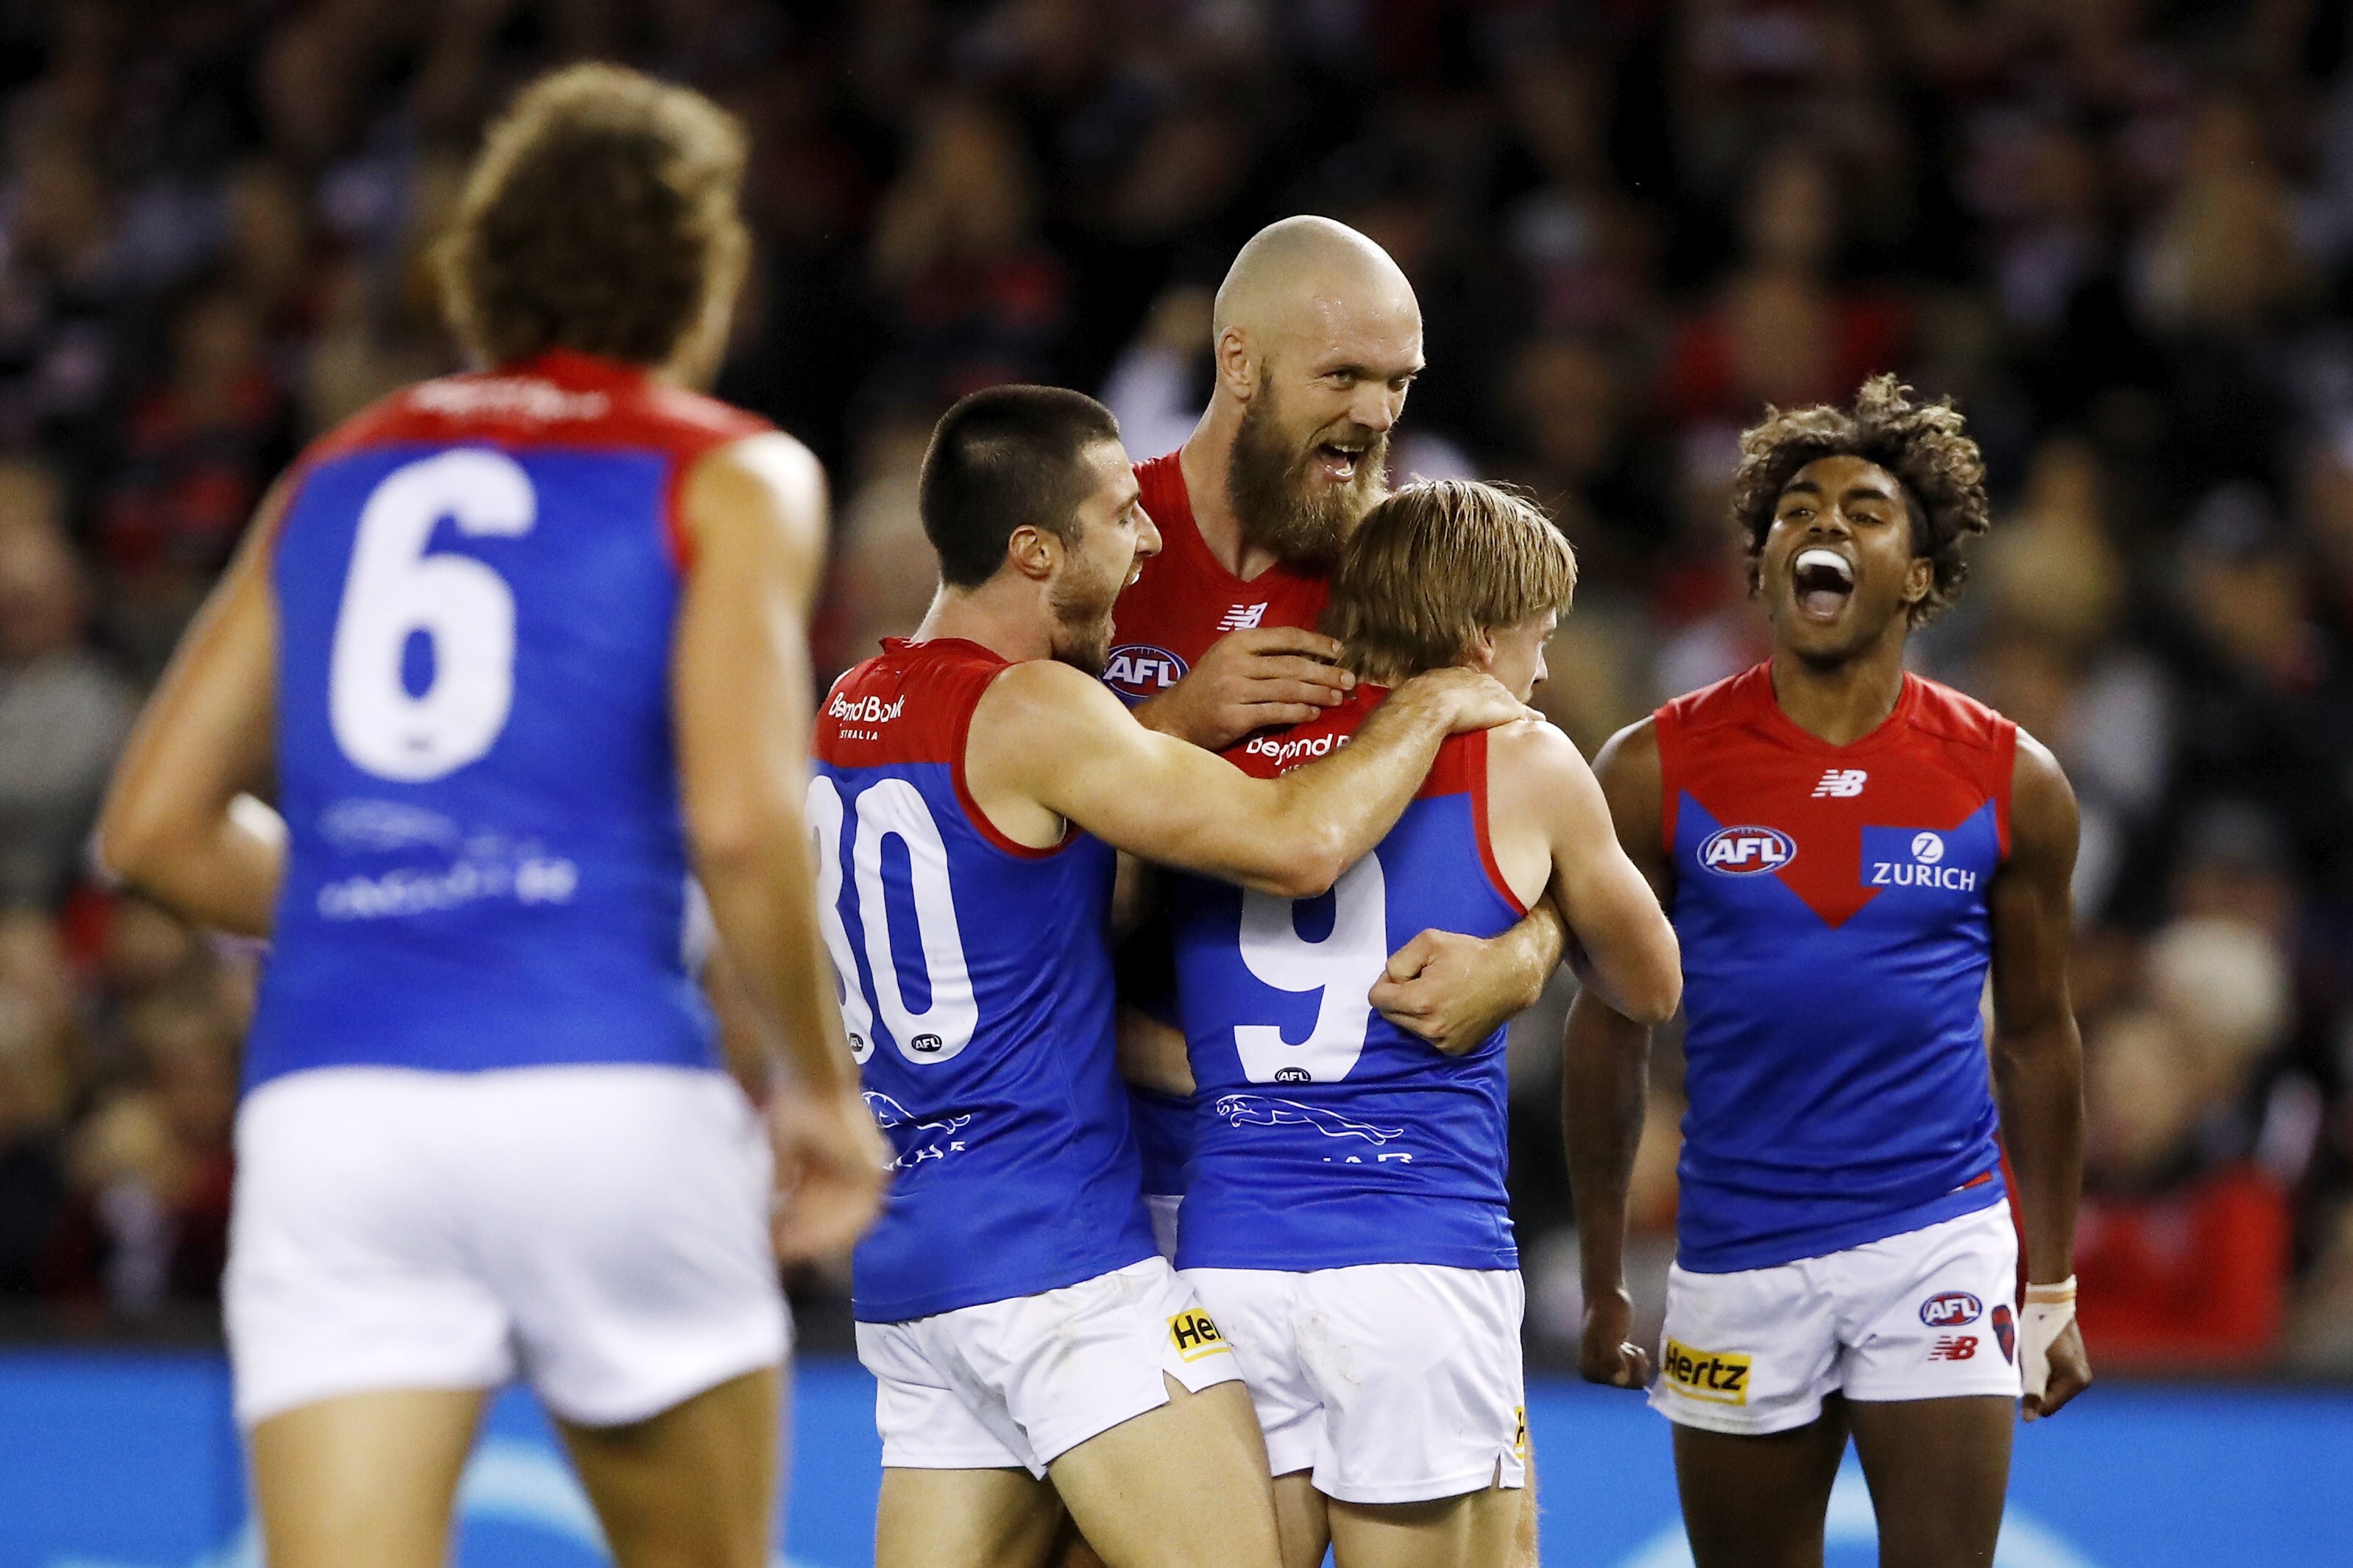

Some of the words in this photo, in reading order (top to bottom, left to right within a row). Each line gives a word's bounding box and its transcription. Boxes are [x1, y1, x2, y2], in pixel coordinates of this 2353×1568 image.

[328, 447, 539, 784] 6
[1103, 656, 1178, 688] AFL
[1706, 837, 1786, 866] AFL
[1872, 862, 1976, 892] ZURICH
[1234, 848, 1387, 1084] 9
[915, 1038, 941, 1049] AFL
[1278, 1072, 1309, 1082] AFL
[1925, 1298, 1979, 1322] AFL
[1665, 1342, 1748, 1391] Hertz
